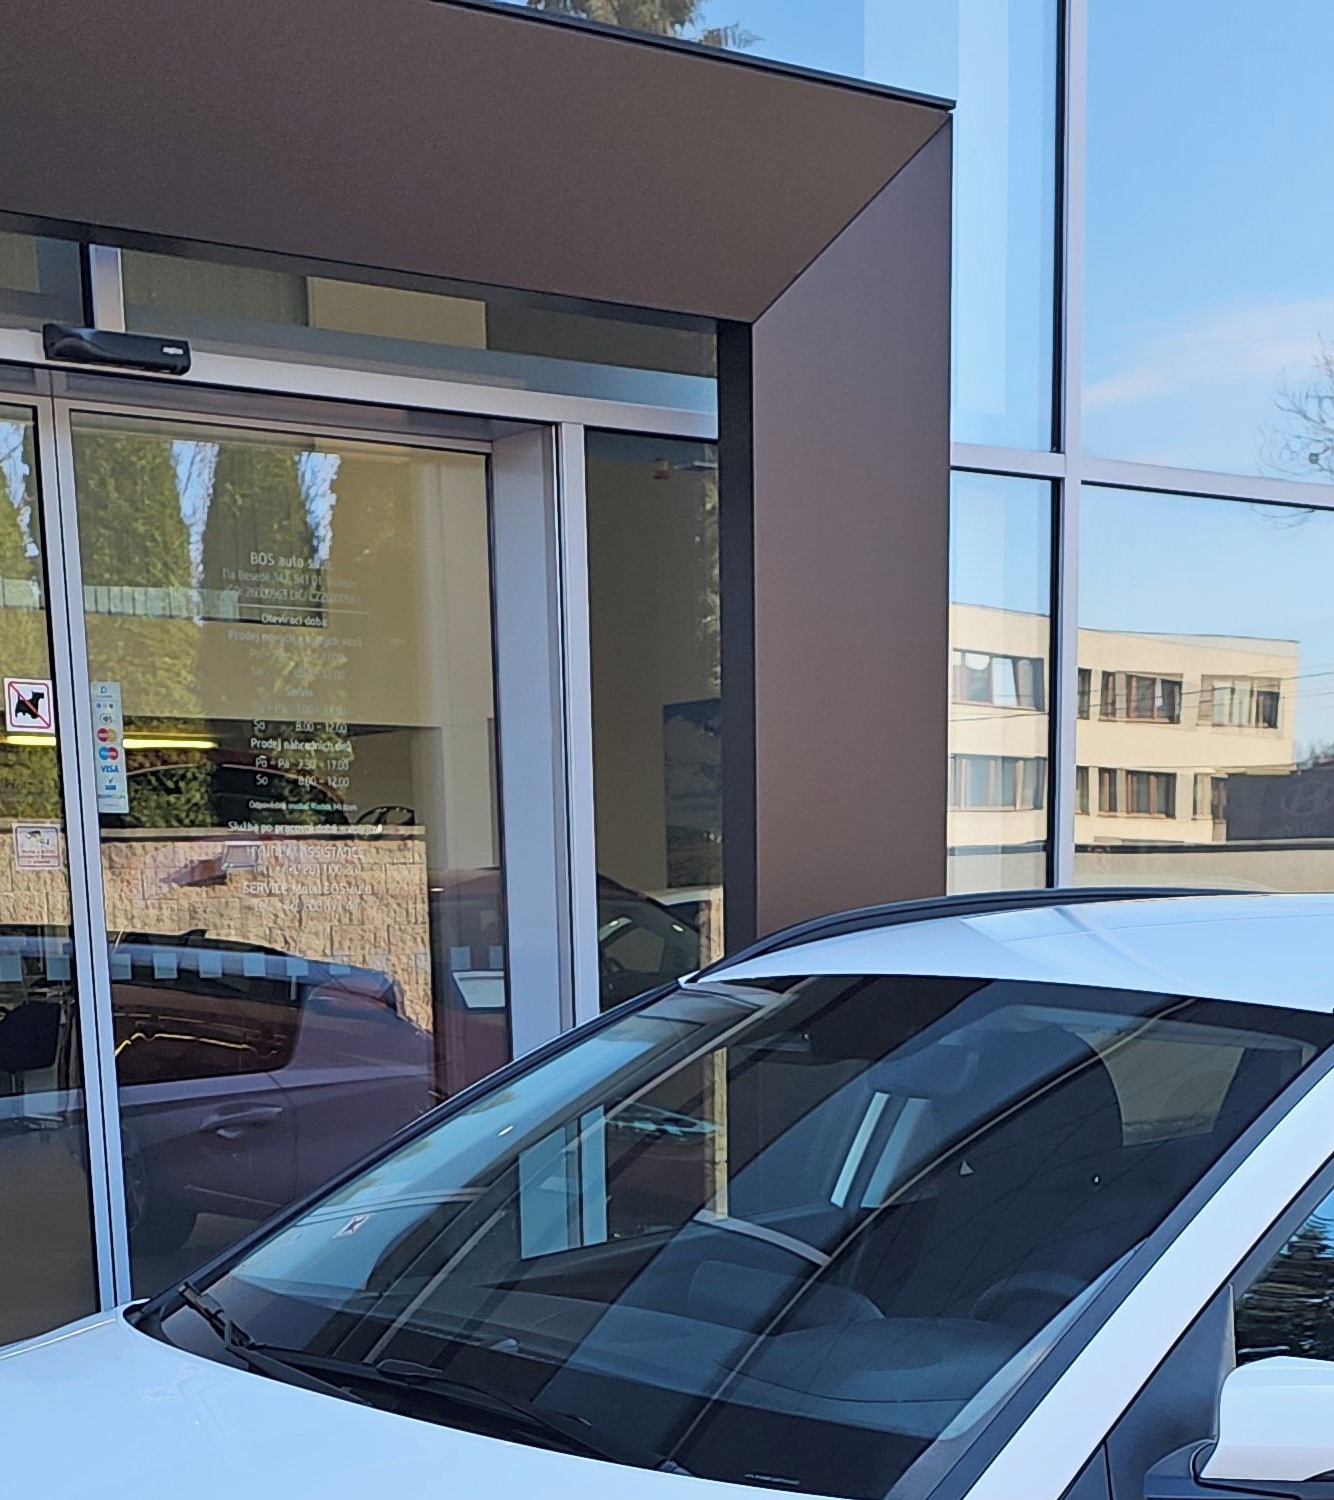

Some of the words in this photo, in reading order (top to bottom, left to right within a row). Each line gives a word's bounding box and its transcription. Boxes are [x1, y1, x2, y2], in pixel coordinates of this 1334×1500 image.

[250, 551, 275, 566] BOS
[278, 555, 304, 569] auto
[250, 737, 282, 751] Prodej
[100, 764, 119, 773] VISA
[326, 759, 349, 771] 17.00
[255, 774, 268, 786] So
[327, 776, 350, 788] 12.00
